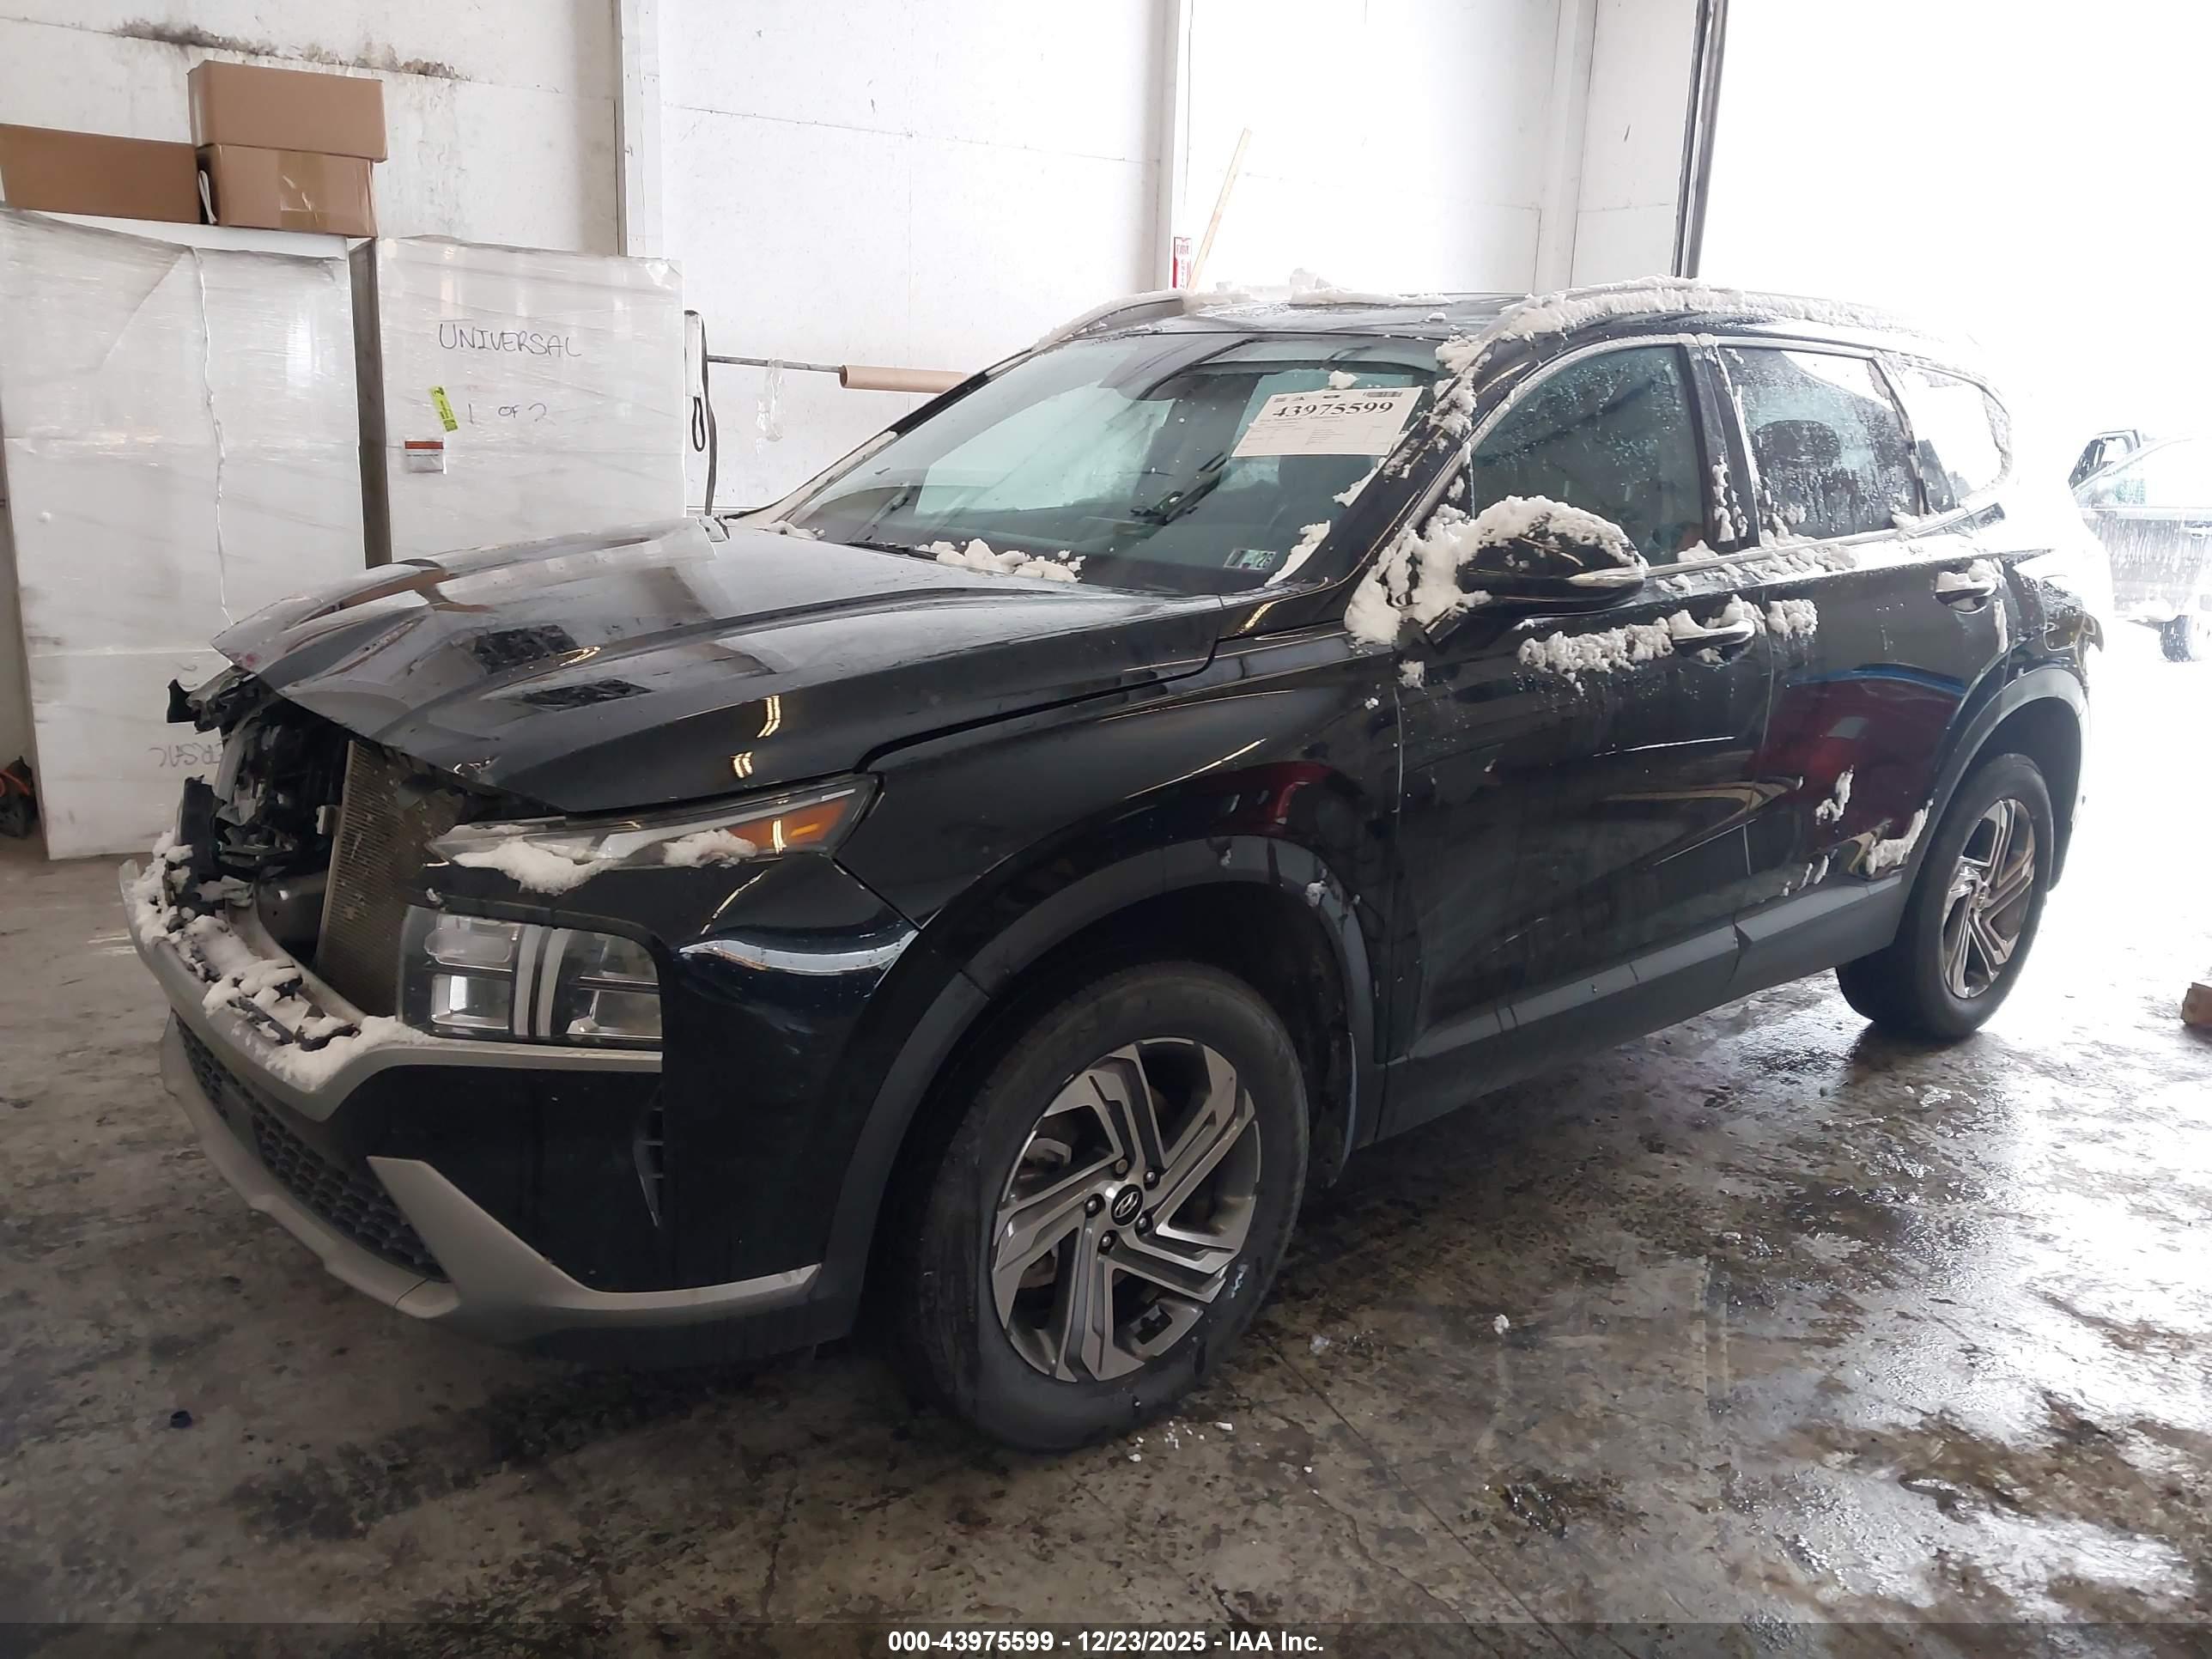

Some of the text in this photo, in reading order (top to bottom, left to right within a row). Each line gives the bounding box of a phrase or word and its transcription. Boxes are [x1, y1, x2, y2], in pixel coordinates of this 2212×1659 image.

[439, 323, 582, 358] UNIVERSAL
[528, 402, 550, 423] 2
[1271, 401, 1395, 417] 43975599
